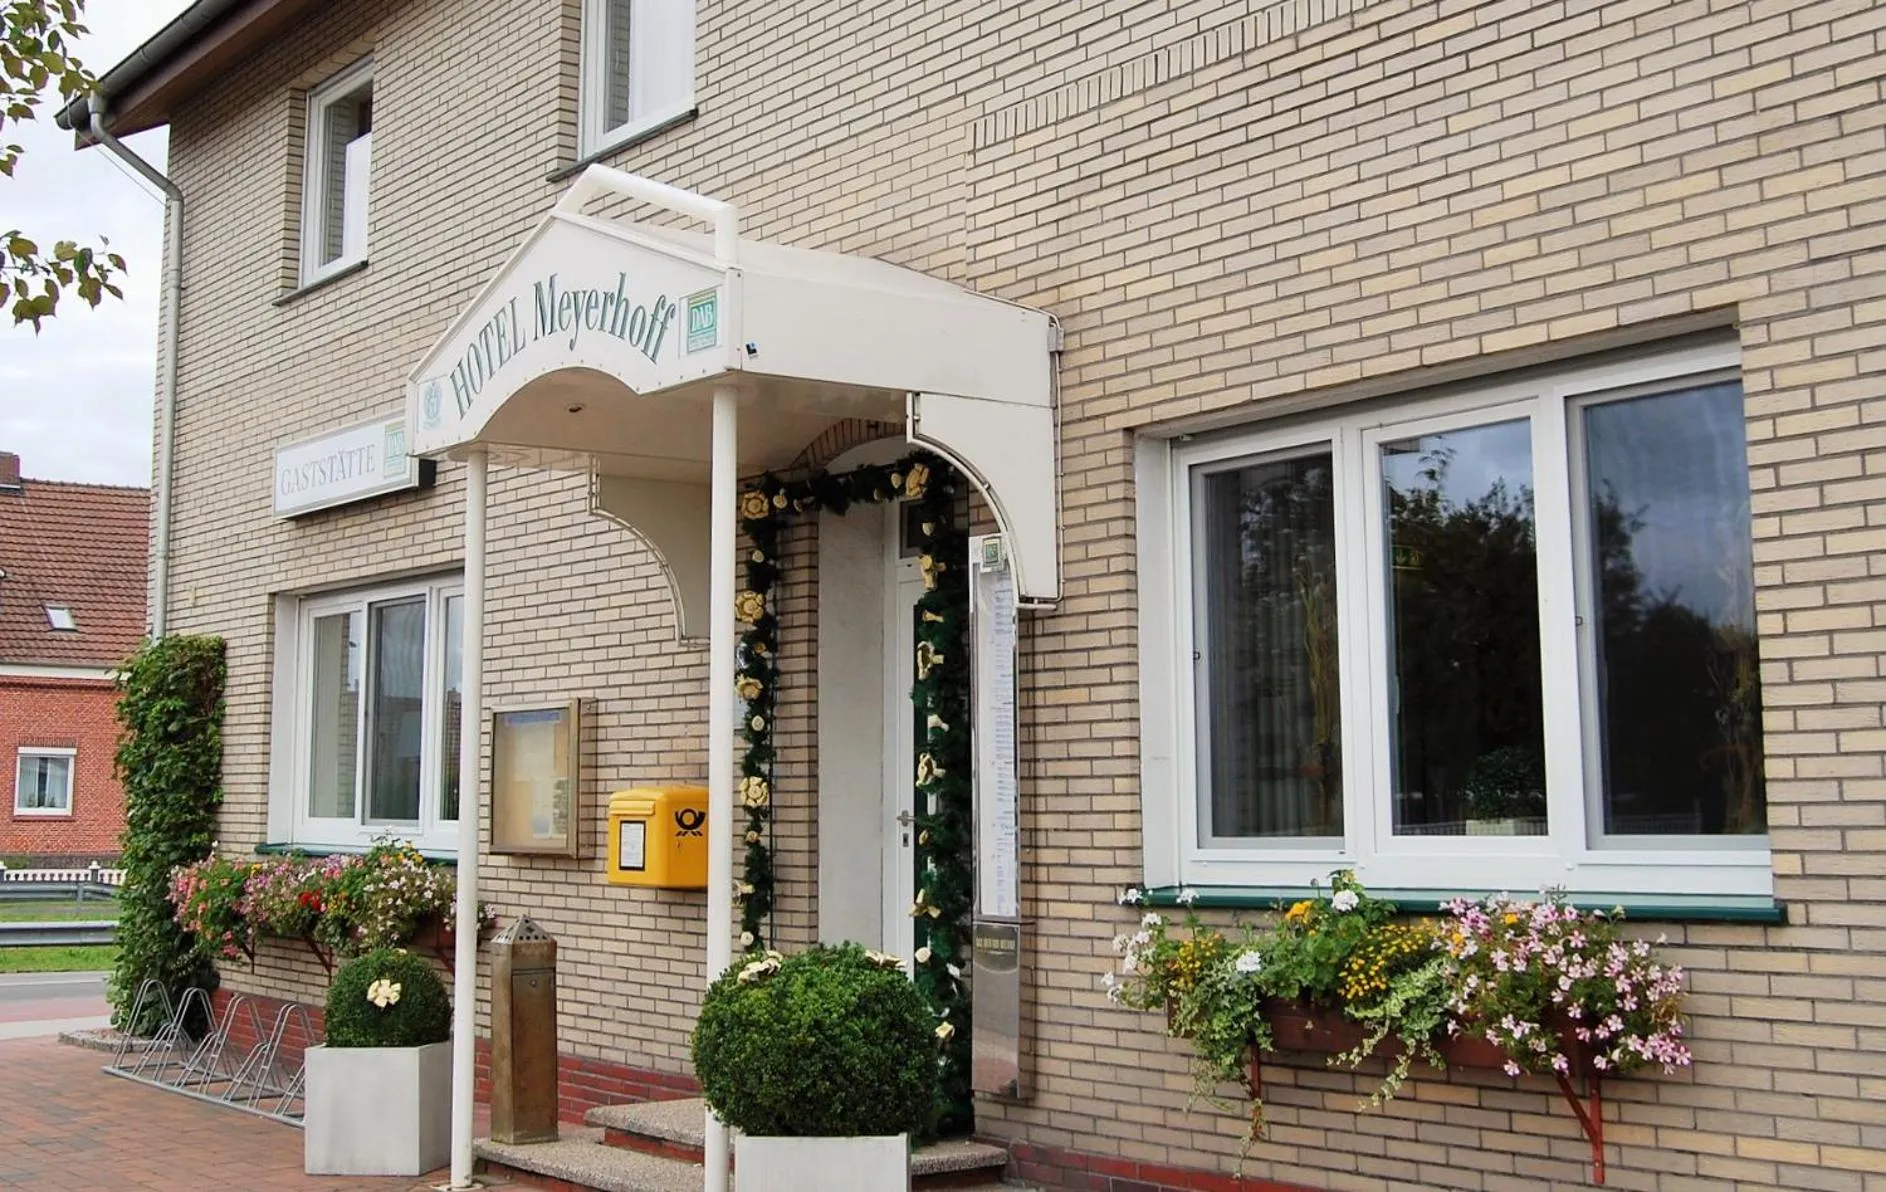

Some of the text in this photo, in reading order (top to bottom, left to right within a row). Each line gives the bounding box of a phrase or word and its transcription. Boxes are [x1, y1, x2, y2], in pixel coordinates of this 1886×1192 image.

[690, 302, 714, 332] DAB
[449, 272, 676, 421] HOTEL Meyerhoff
[280, 444, 376, 496] GASTSTÄTTE
